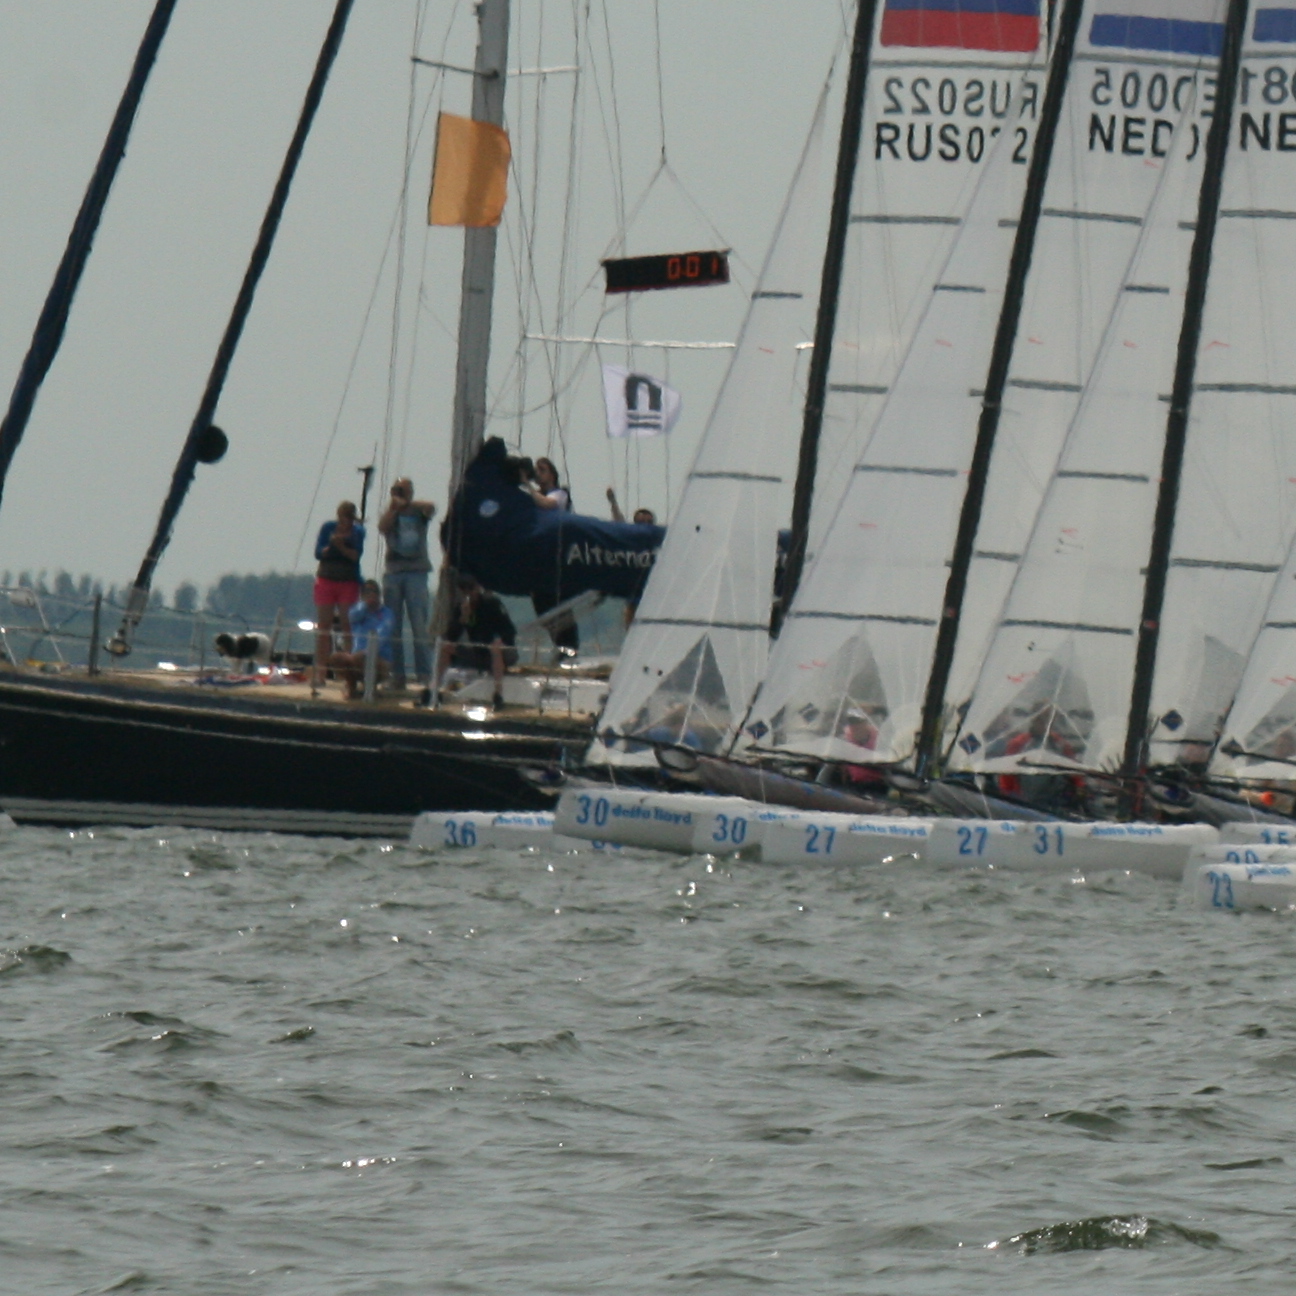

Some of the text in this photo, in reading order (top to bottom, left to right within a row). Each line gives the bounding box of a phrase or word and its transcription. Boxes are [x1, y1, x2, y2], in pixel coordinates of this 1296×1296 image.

[576, 794, 609, 827] 30
[712, 813, 748, 845] 30
[805, 823, 837, 855] 27
[957, 825, 989, 855] 27
[1033, 824, 1065, 856] 31
